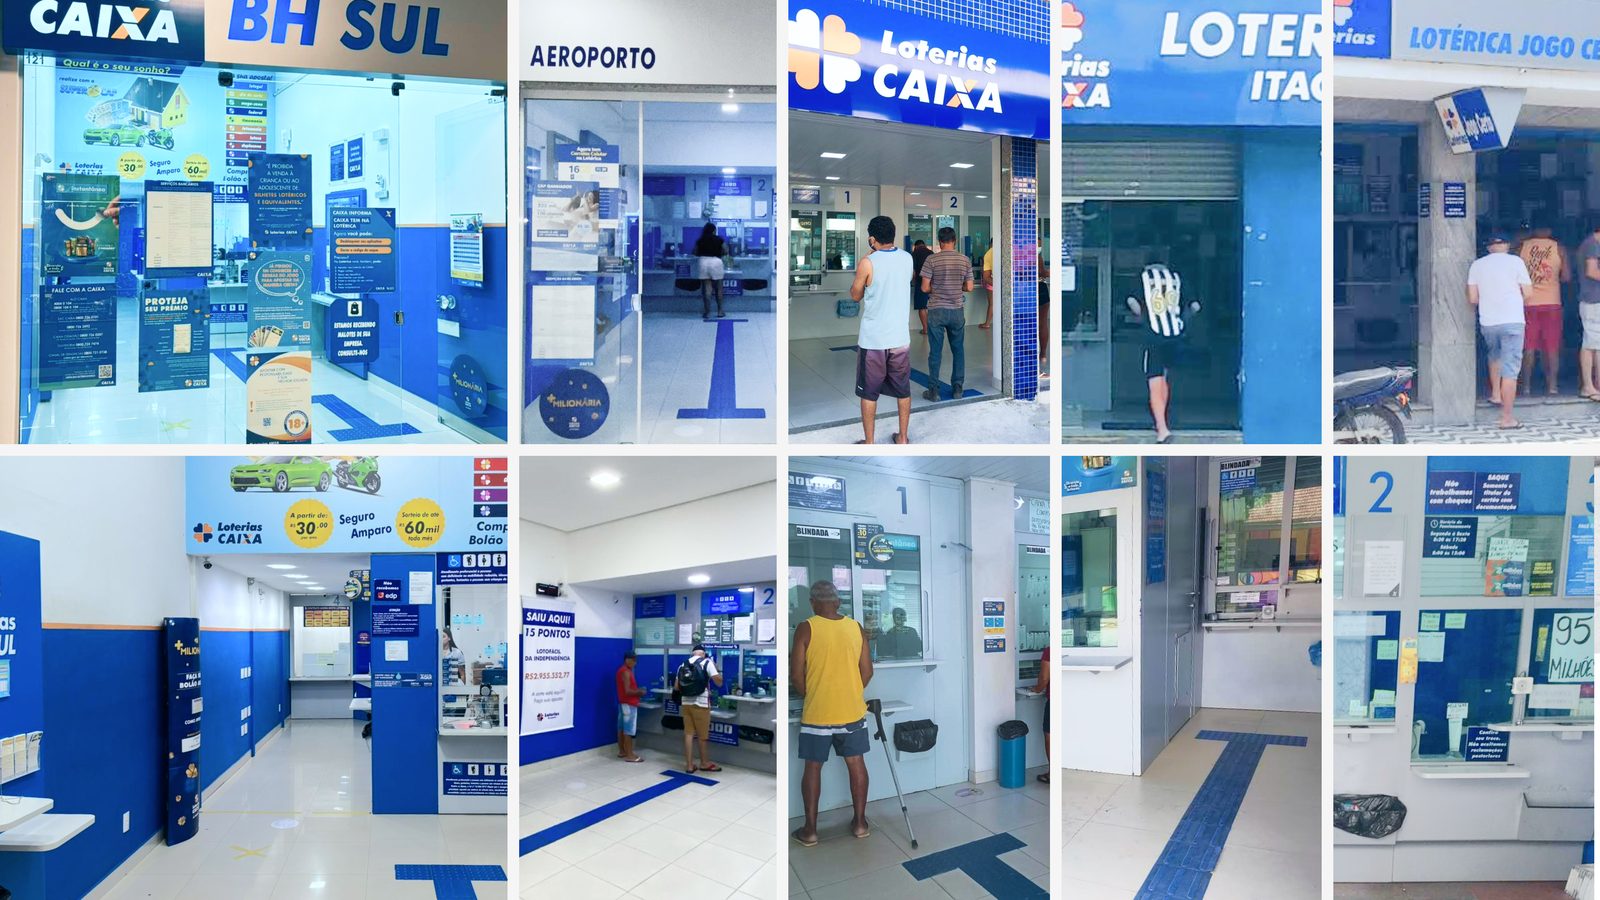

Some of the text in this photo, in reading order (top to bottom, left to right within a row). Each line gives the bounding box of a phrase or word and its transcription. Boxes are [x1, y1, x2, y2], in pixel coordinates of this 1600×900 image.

[29, 1, 180, 43] CAIXA
[228, 0, 450, 57] BH SUL
[1409, 24, 1512, 54] LOTÉRICA
[1518, 35, 1574, 59] JOGO
[530, 45, 656, 70] AEROPORTO
[880, 29, 997, 75] Loterias
[63, 58, 92, 69] Qual
[134, 65, 170, 75] sonho?
[873, 63, 1003, 114] CAIXA
[1462, 116, 1480, 140] Jogo
[149, 160, 171, 169] Seguro
[187, 165, 200, 175] 60
[156, 168, 181, 176] Amparo
[692, 180, 697, 191] 1
[757, 179, 765, 192] 2
[844, 190, 850, 204] 1
[950, 196, 958, 209] 2
[145, 297, 189, 305] PROTEJA
[1487, 473, 1510, 481] SAQUE
[1368, 470, 1394, 514] 2
[1429, 488, 1473, 496] trabalhamos
[896, 486, 908, 515] 1
[1445, 497, 1472, 505] cheques
[1475, 503, 1517, 511] documentação
[297, 512, 313, 521] partir
[339, 511, 375, 526] Seguro
[217, 521, 263, 533] Loterias
[350, 524, 392, 540] Amparo
[404, 520, 440, 535] 60 mil
[796, 526, 830, 537] BLINDADA
[217, 533, 263, 545] CAIXA
[469, 534, 504, 546] Bolão
[385, 592, 398, 600] edp
[763, 588, 775, 605] 2
[682, 596, 688, 611] 1
[526, 612, 571, 625] SAIU AQUI!
[525, 627, 571, 639] 15 PONTOS
[1556, 615, 1594, 646] 95
[179, 680, 198, 689] BOLÃO
